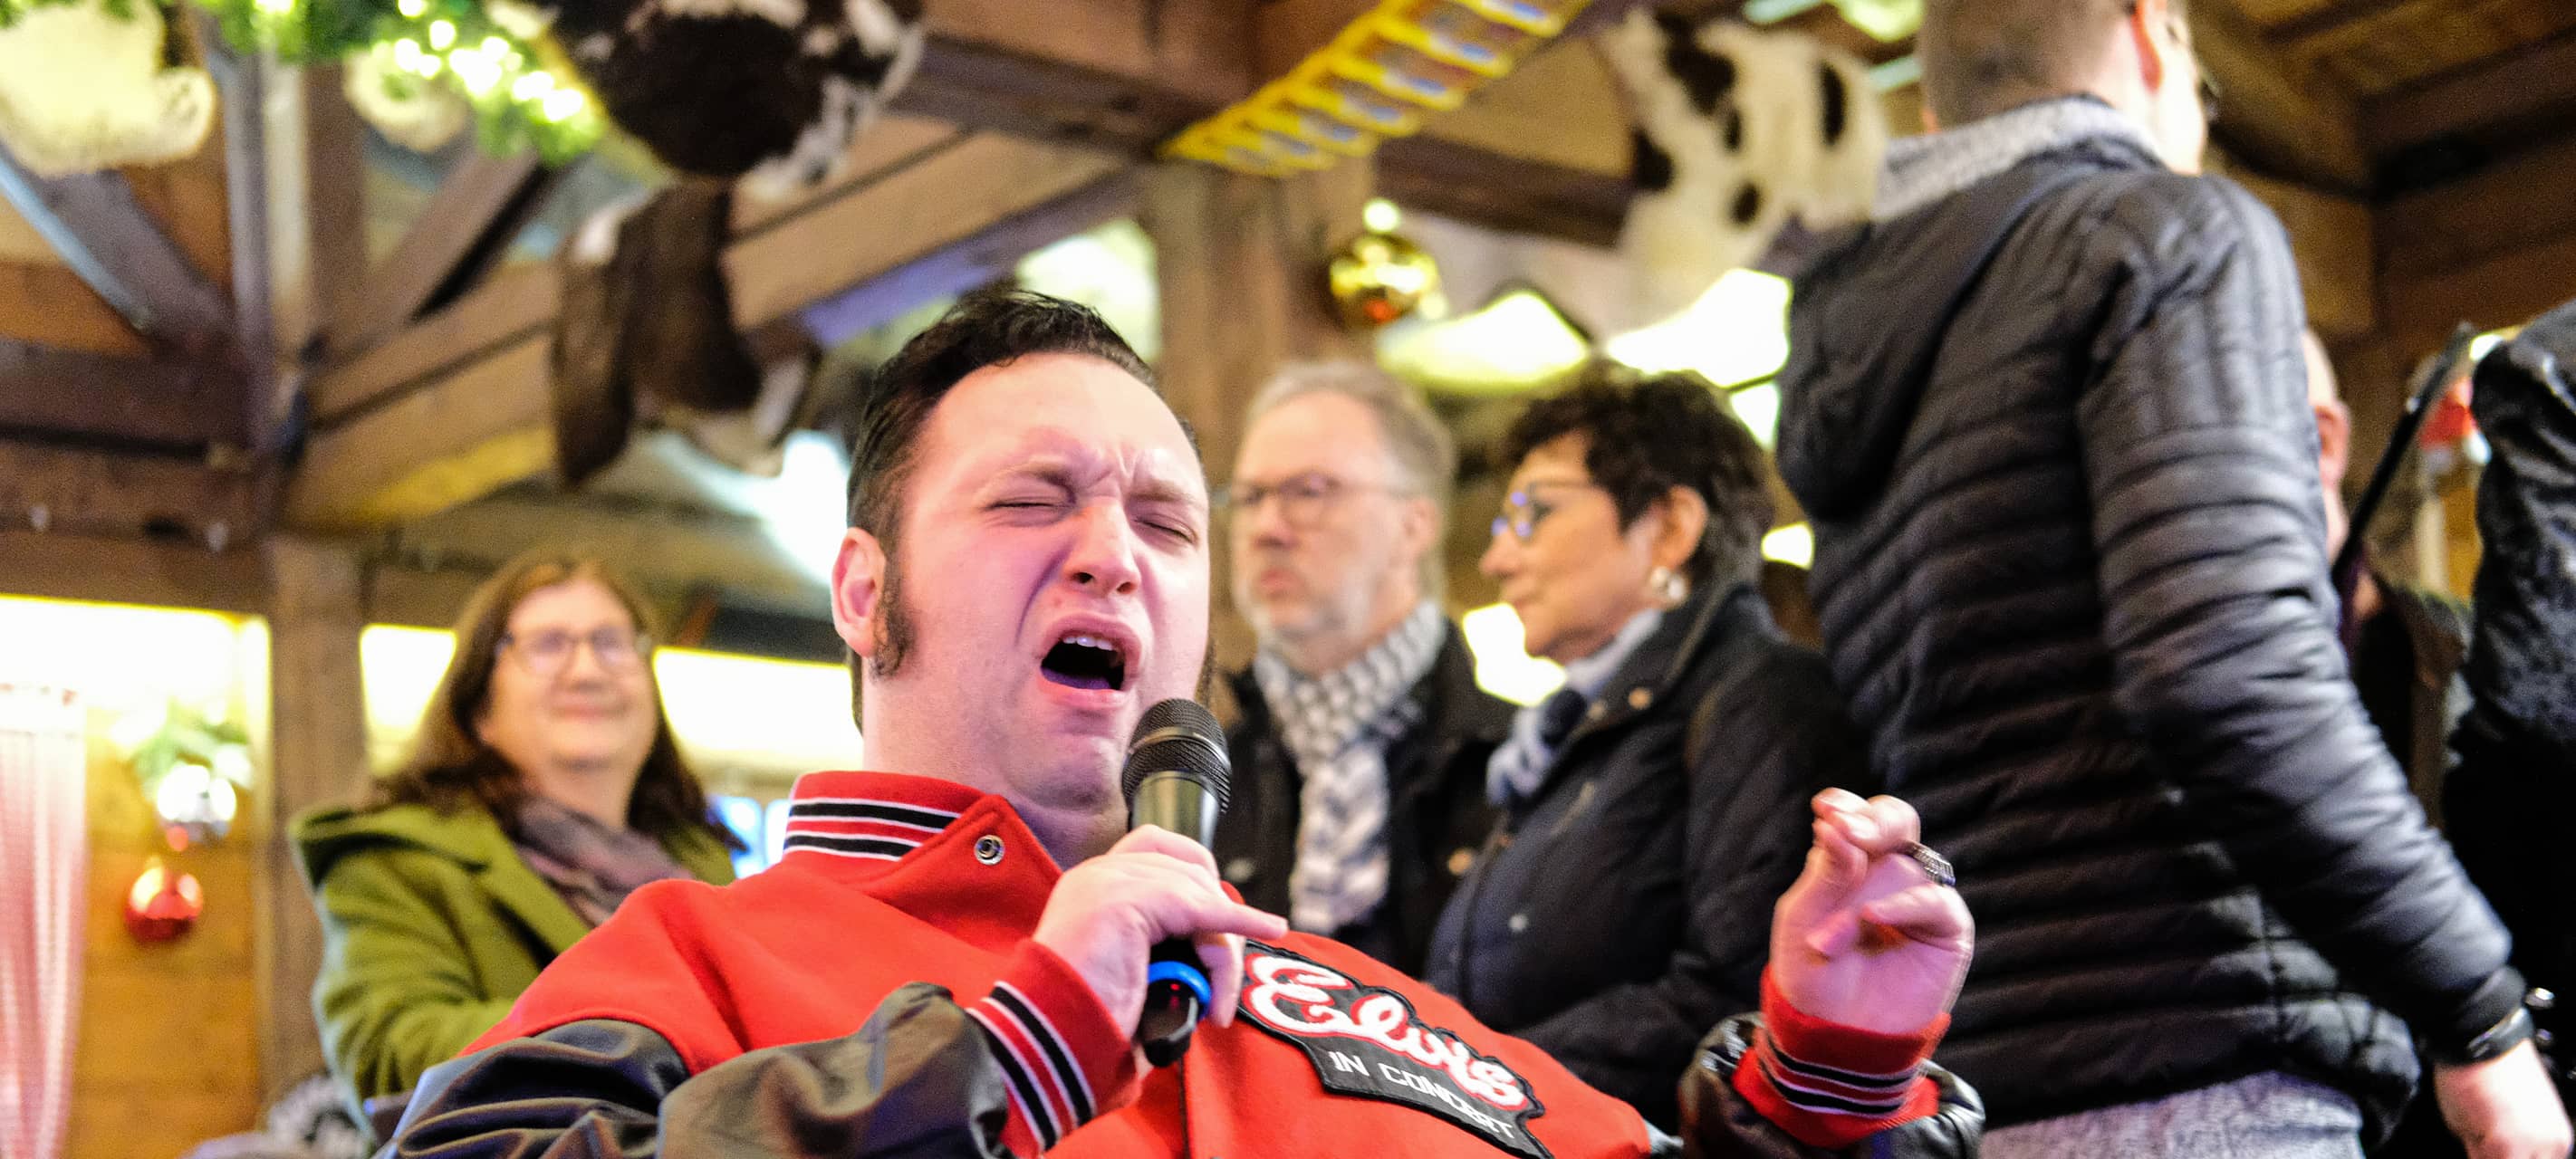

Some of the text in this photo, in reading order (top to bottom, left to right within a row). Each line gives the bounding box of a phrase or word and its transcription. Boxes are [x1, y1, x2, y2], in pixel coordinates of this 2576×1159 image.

[1245, 953, 1528, 1110] Elvis
[1328, 1050, 1515, 1139] IN CONCERT
